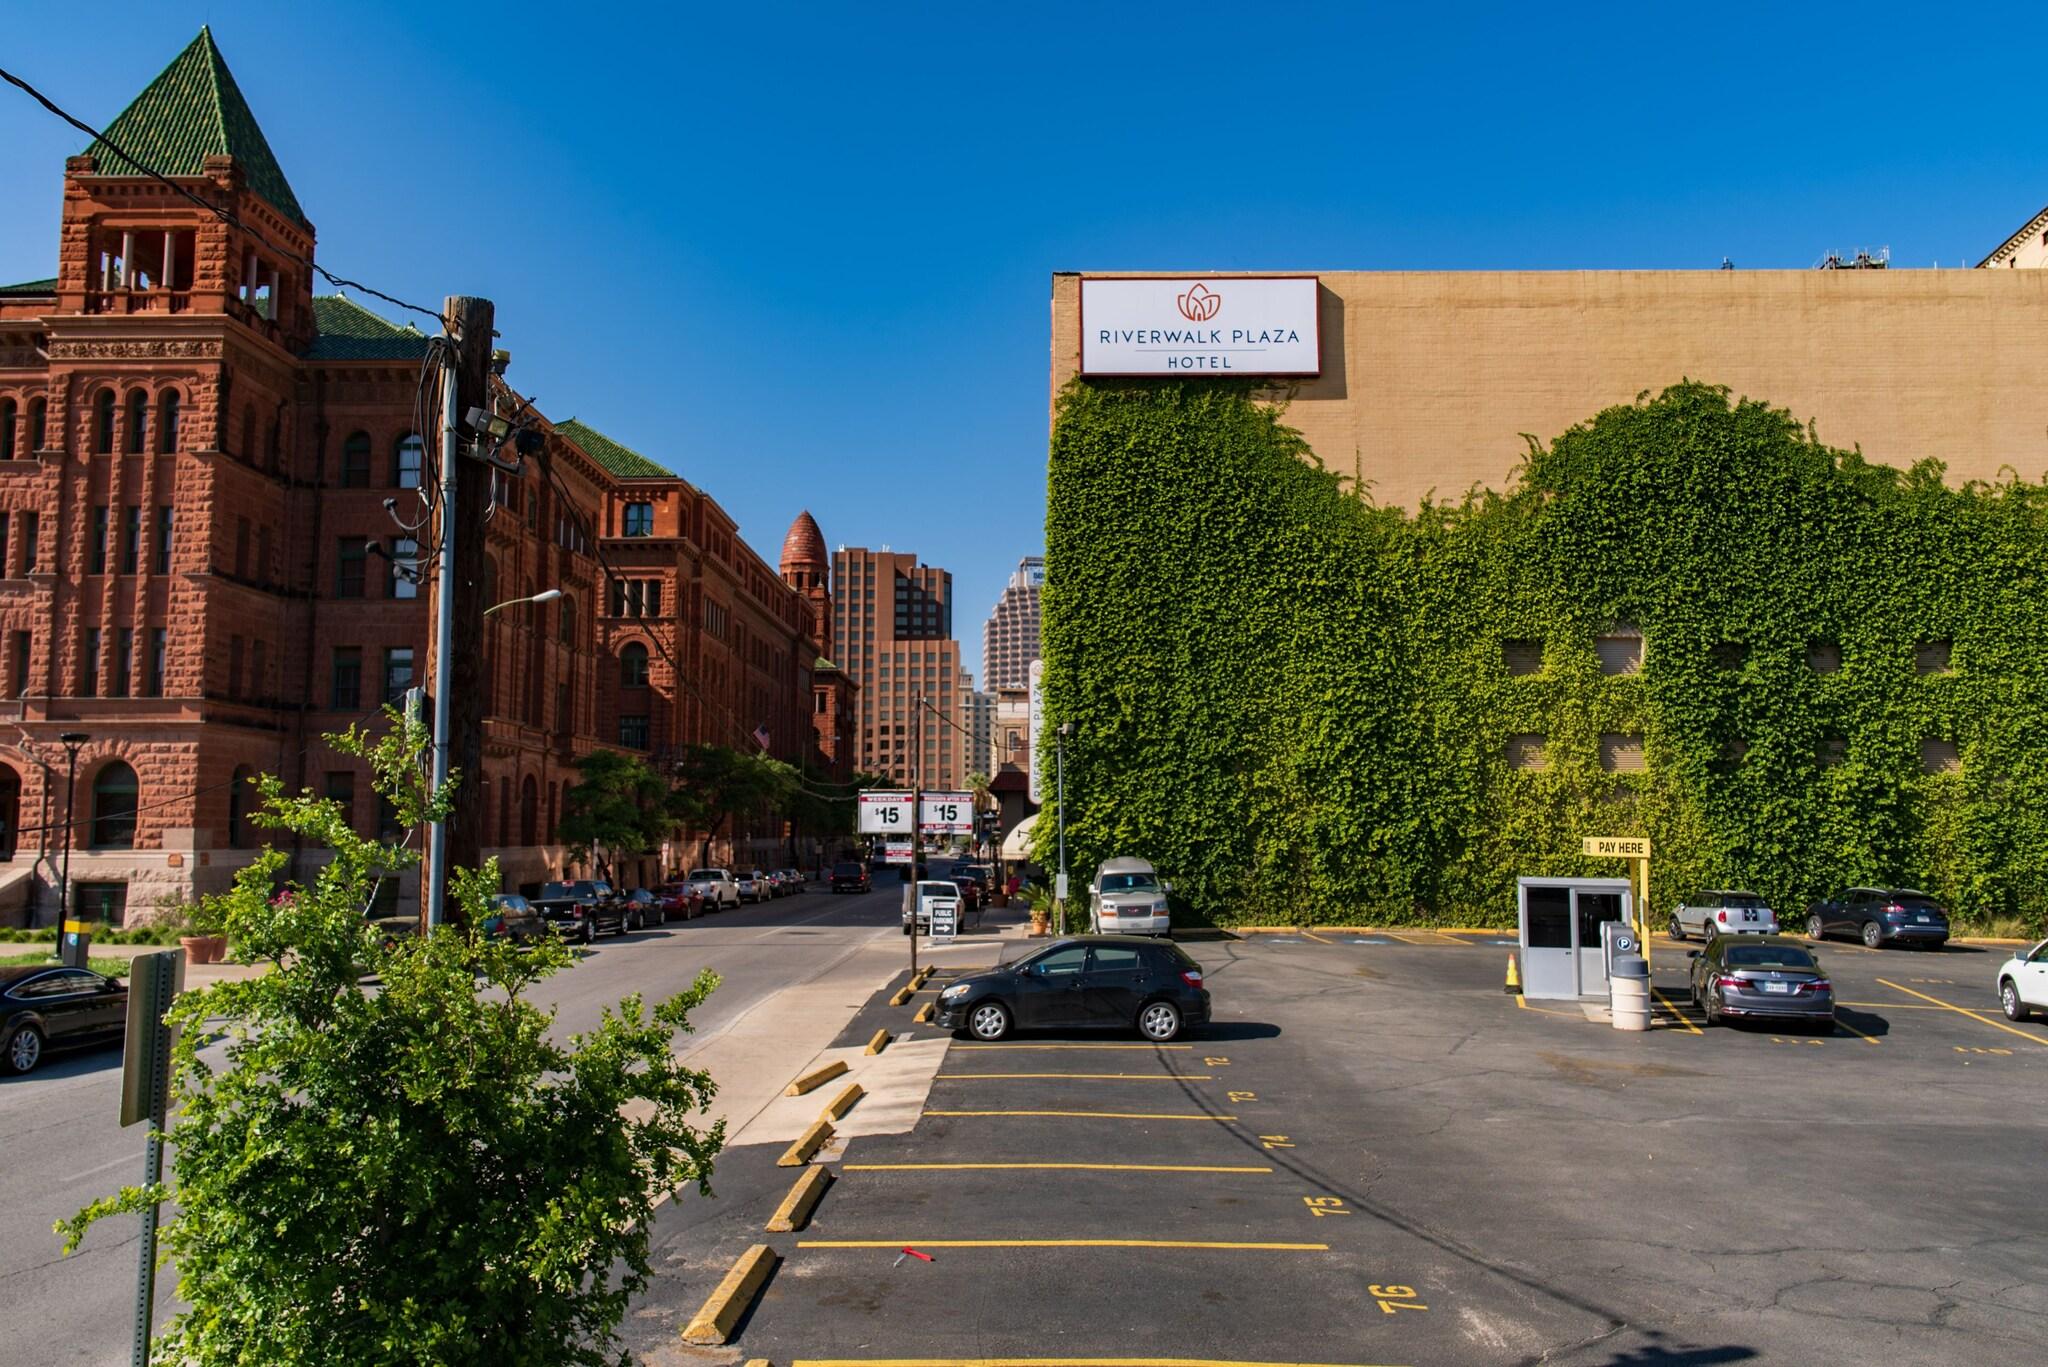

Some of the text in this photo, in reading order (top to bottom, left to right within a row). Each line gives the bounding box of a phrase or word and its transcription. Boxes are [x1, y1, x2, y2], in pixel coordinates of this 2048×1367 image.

[1100, 329, 1299, 344] RIVERWALK PLAZA
[1168, 356, 1232, 369] HOTEL
[875, 807, 899, 823] $15
[934, 804, 957, 821] $15
[1599, 842, 1616, 853] PAY
[1618, 842, 1644, 854] HERE
